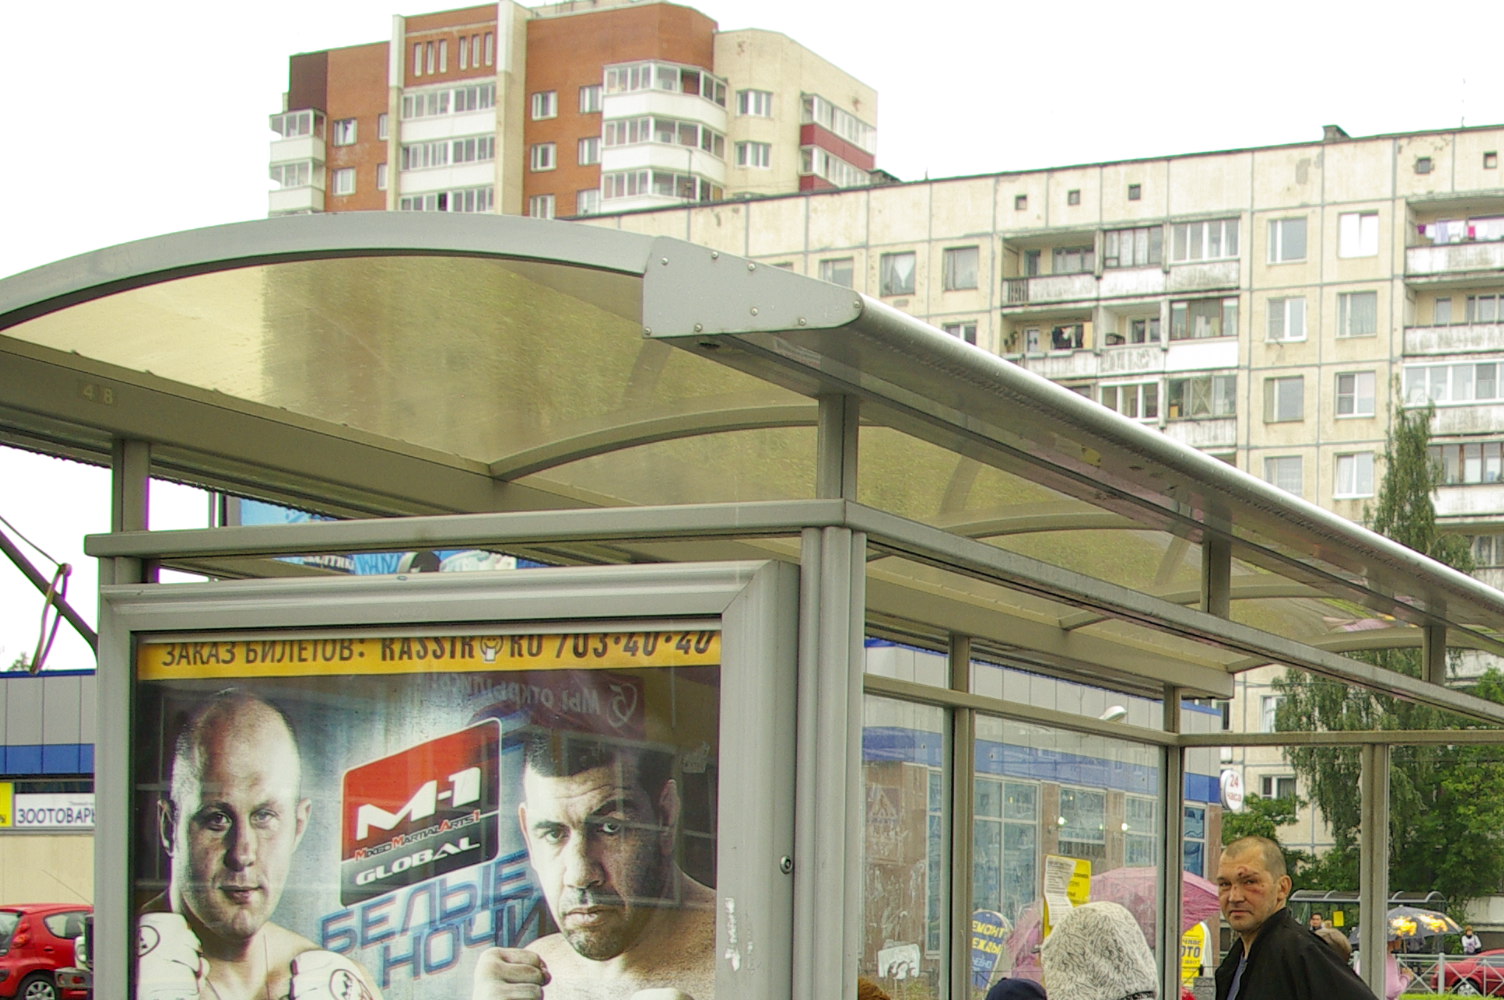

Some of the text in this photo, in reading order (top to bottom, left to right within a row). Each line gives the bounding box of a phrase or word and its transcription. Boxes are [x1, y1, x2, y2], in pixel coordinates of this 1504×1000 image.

[161, 642, 237, 667] ЗАКАЗ
[356, 767, 481, 841] M-1
[355, 836, 480, 886] GLOBAL
